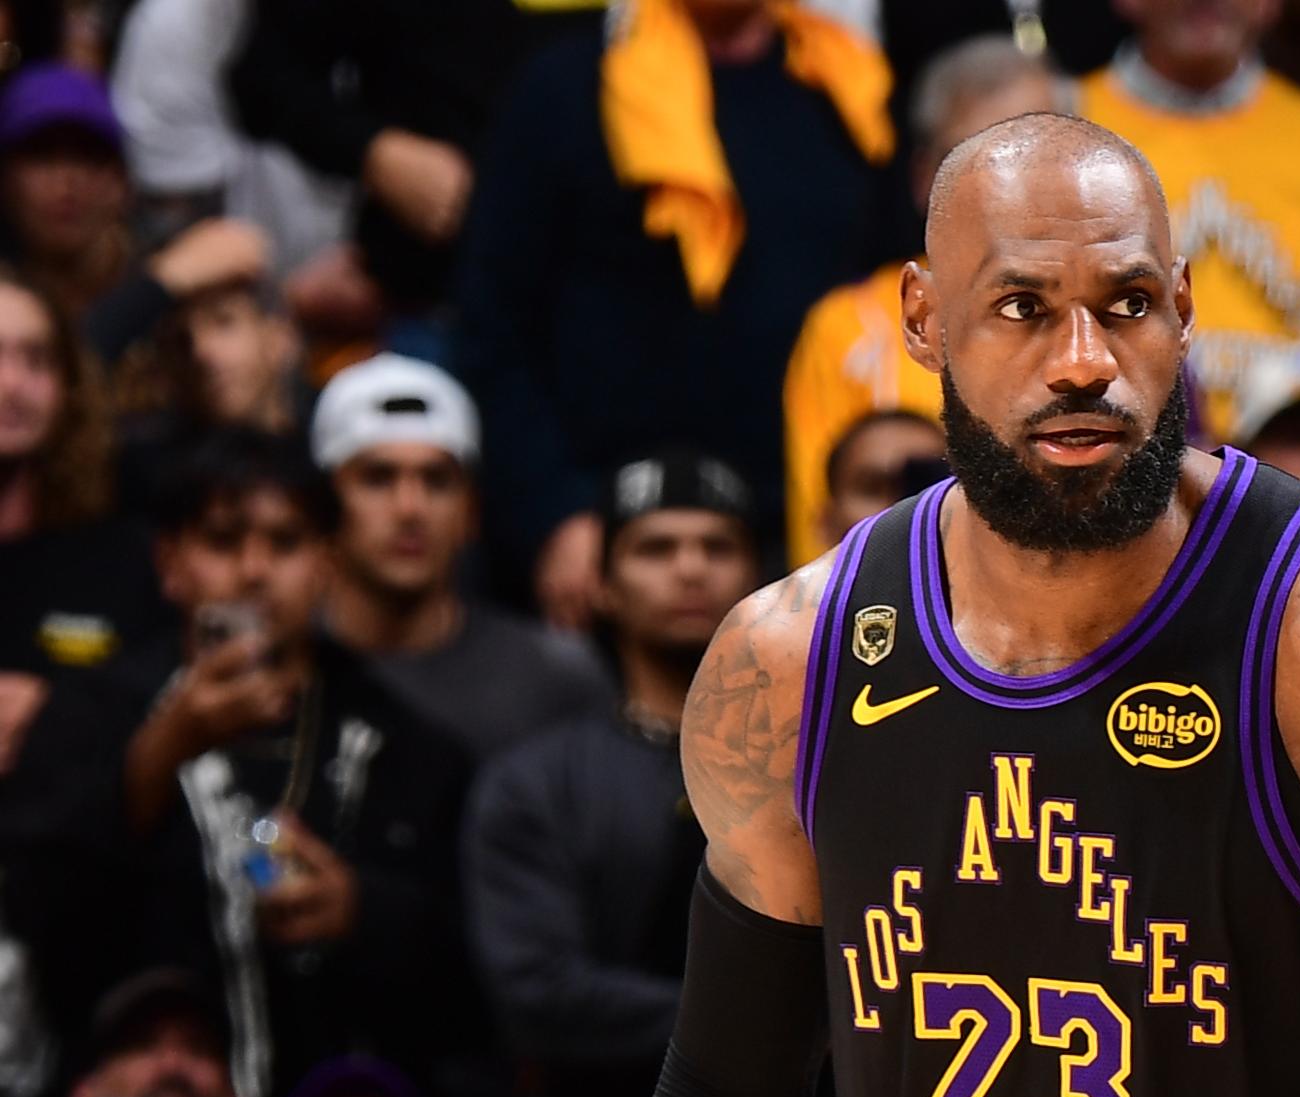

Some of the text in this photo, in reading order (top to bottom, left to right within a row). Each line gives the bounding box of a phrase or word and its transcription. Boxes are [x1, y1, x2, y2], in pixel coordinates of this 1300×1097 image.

[1118, 703, 1214, 744] bibigo
[1133, 733, 1175, 749] 비비고
[840, 752, 1229, 1046] LOS ANGELES
